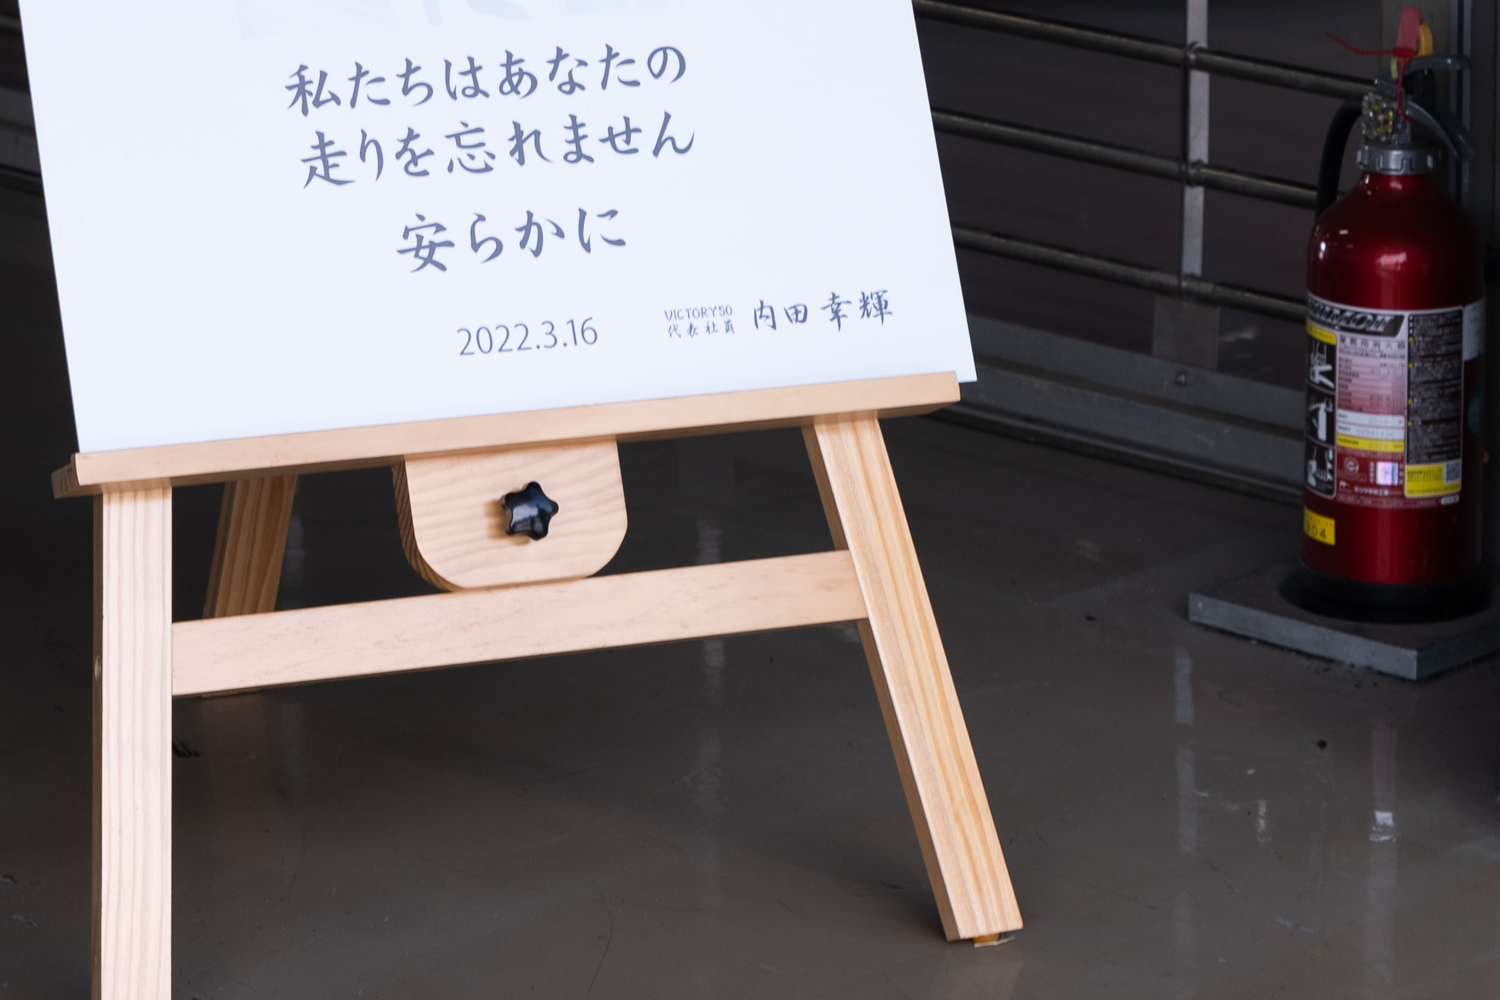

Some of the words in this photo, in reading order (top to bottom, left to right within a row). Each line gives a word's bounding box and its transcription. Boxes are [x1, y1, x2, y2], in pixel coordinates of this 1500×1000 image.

[284, 42, 687, 117] 私たちはあなたの
[300, 111, 695, 189] 走りを忘れません
[395, 207, 627, 274] 安らかに
[456, 317, 599, 357] 2022.3.16
[663, 304, 733, 321] VICTORY50
